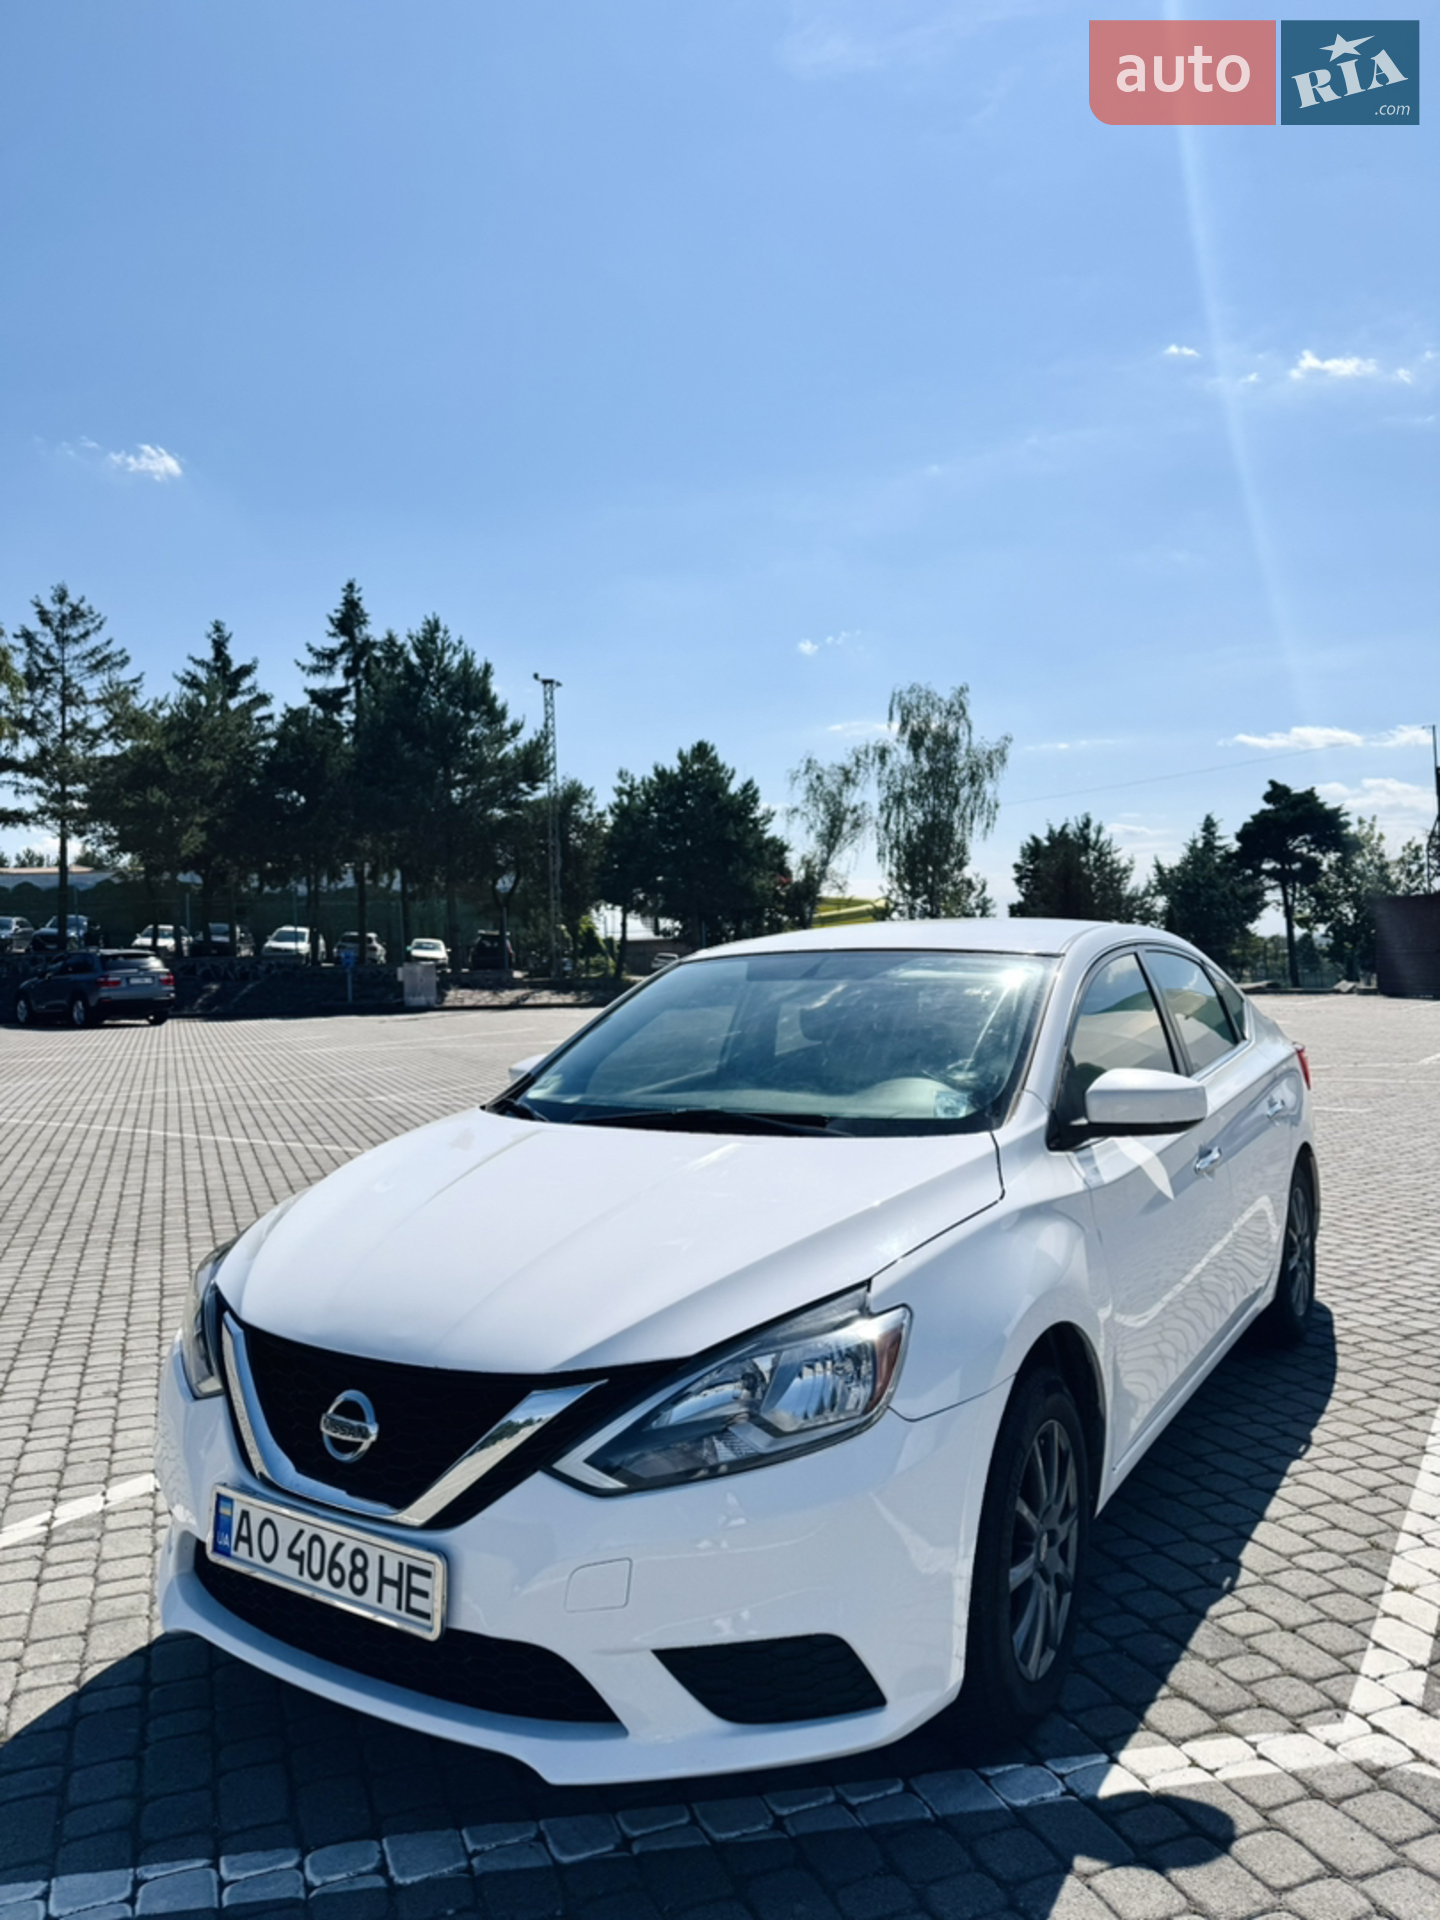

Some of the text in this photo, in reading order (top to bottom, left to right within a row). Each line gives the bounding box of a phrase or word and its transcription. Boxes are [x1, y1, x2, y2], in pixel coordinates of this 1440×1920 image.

[216, 1530, 230, 1548] UA
[234, 1509, 432, 1621] AO 4068 HE
